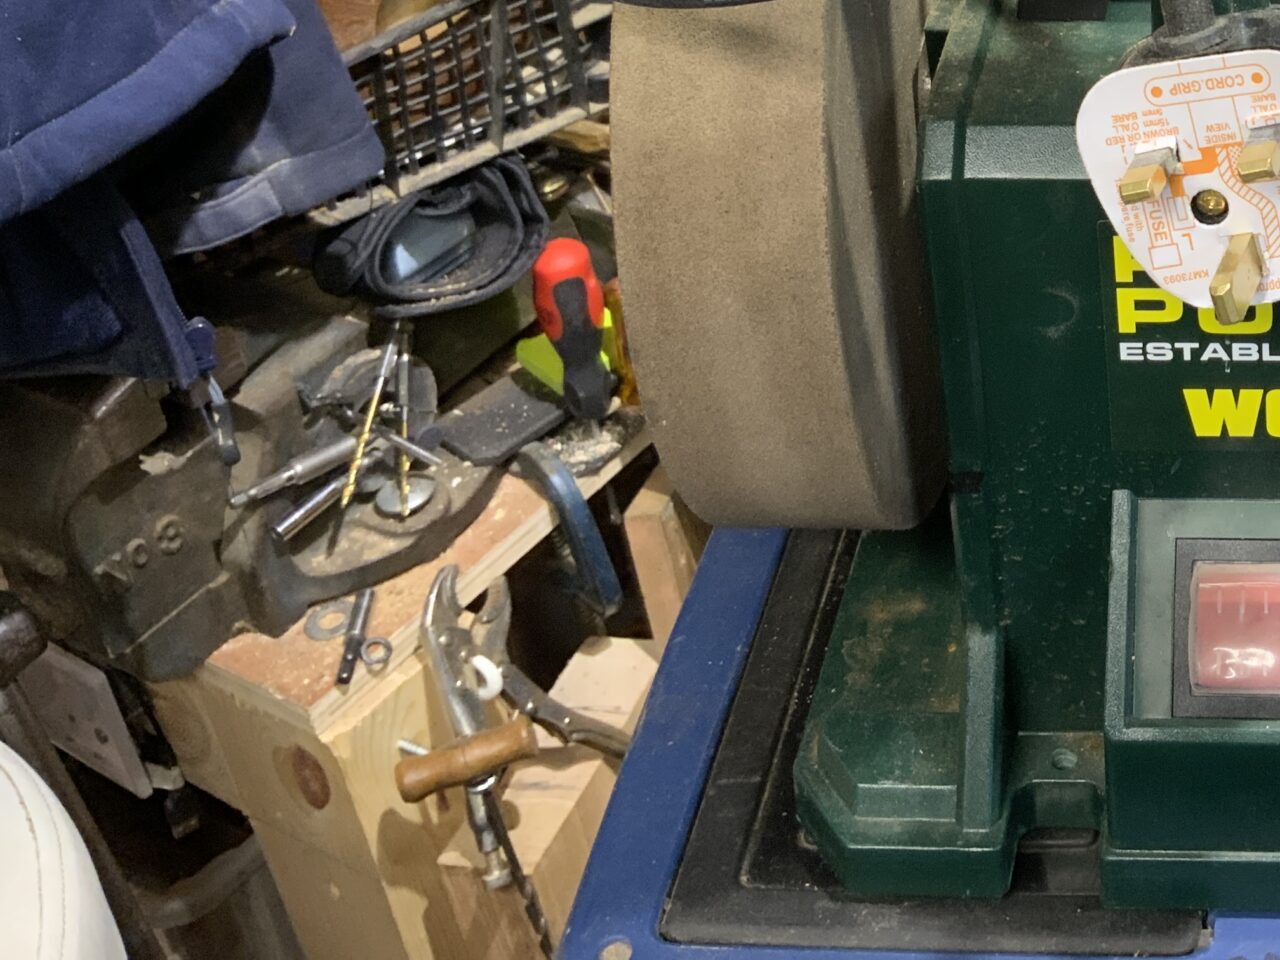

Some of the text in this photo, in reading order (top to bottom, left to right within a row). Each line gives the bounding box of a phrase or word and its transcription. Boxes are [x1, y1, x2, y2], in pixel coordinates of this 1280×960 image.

[1206, 122, 1231, 133] VIEW
[1105, 135, 1126, 146] RED
[1204, 132, 1237, 145] INSIDE
[1146, 200, 1168, 243] FUSE
[1181, 232, 1194, 251] L
